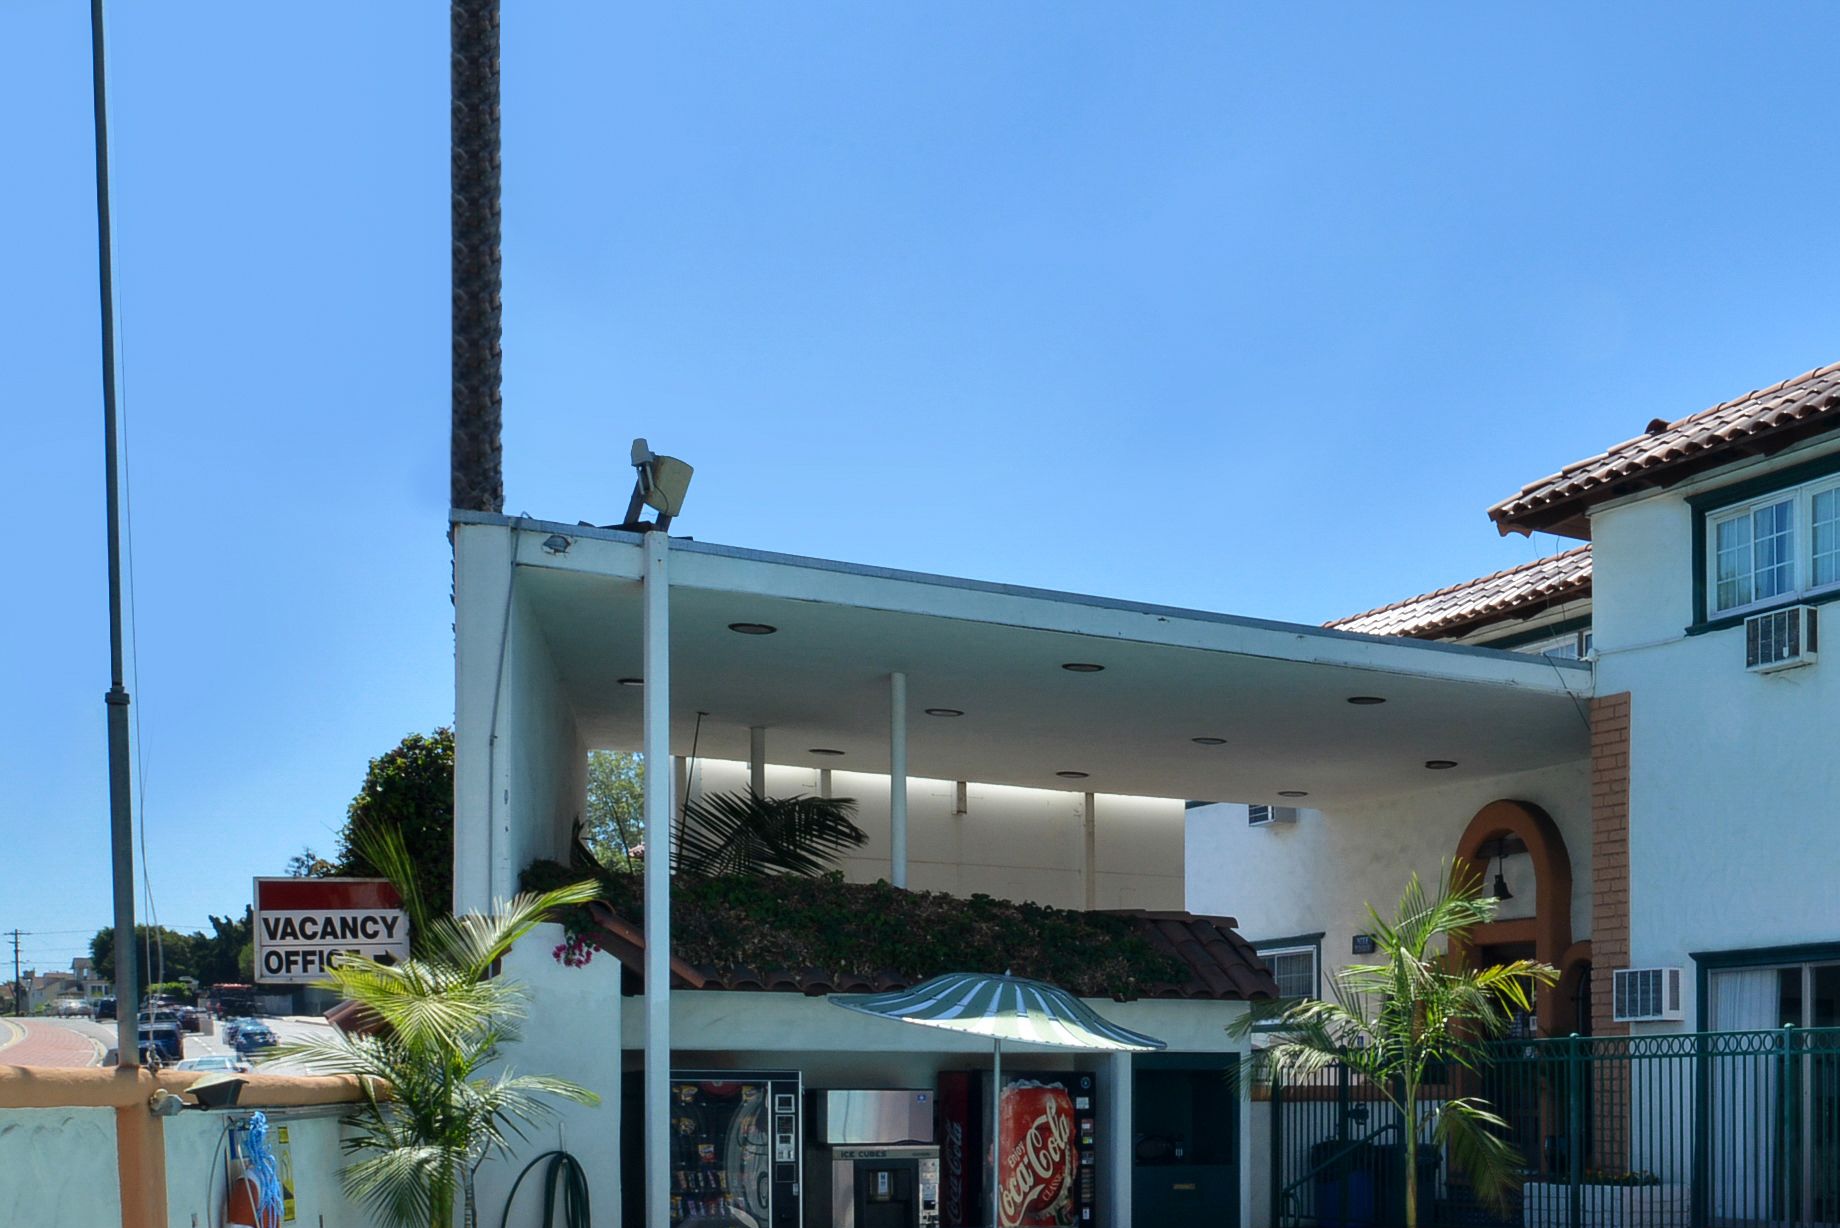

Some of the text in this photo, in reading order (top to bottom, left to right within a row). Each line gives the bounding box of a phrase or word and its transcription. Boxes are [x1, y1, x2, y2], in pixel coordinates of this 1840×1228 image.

[262, 915, 400, 940] VACANCY
[264, 949, 360, 974] OFFIC
[1000, 1095, 1070, 1227] Coca-Cola
